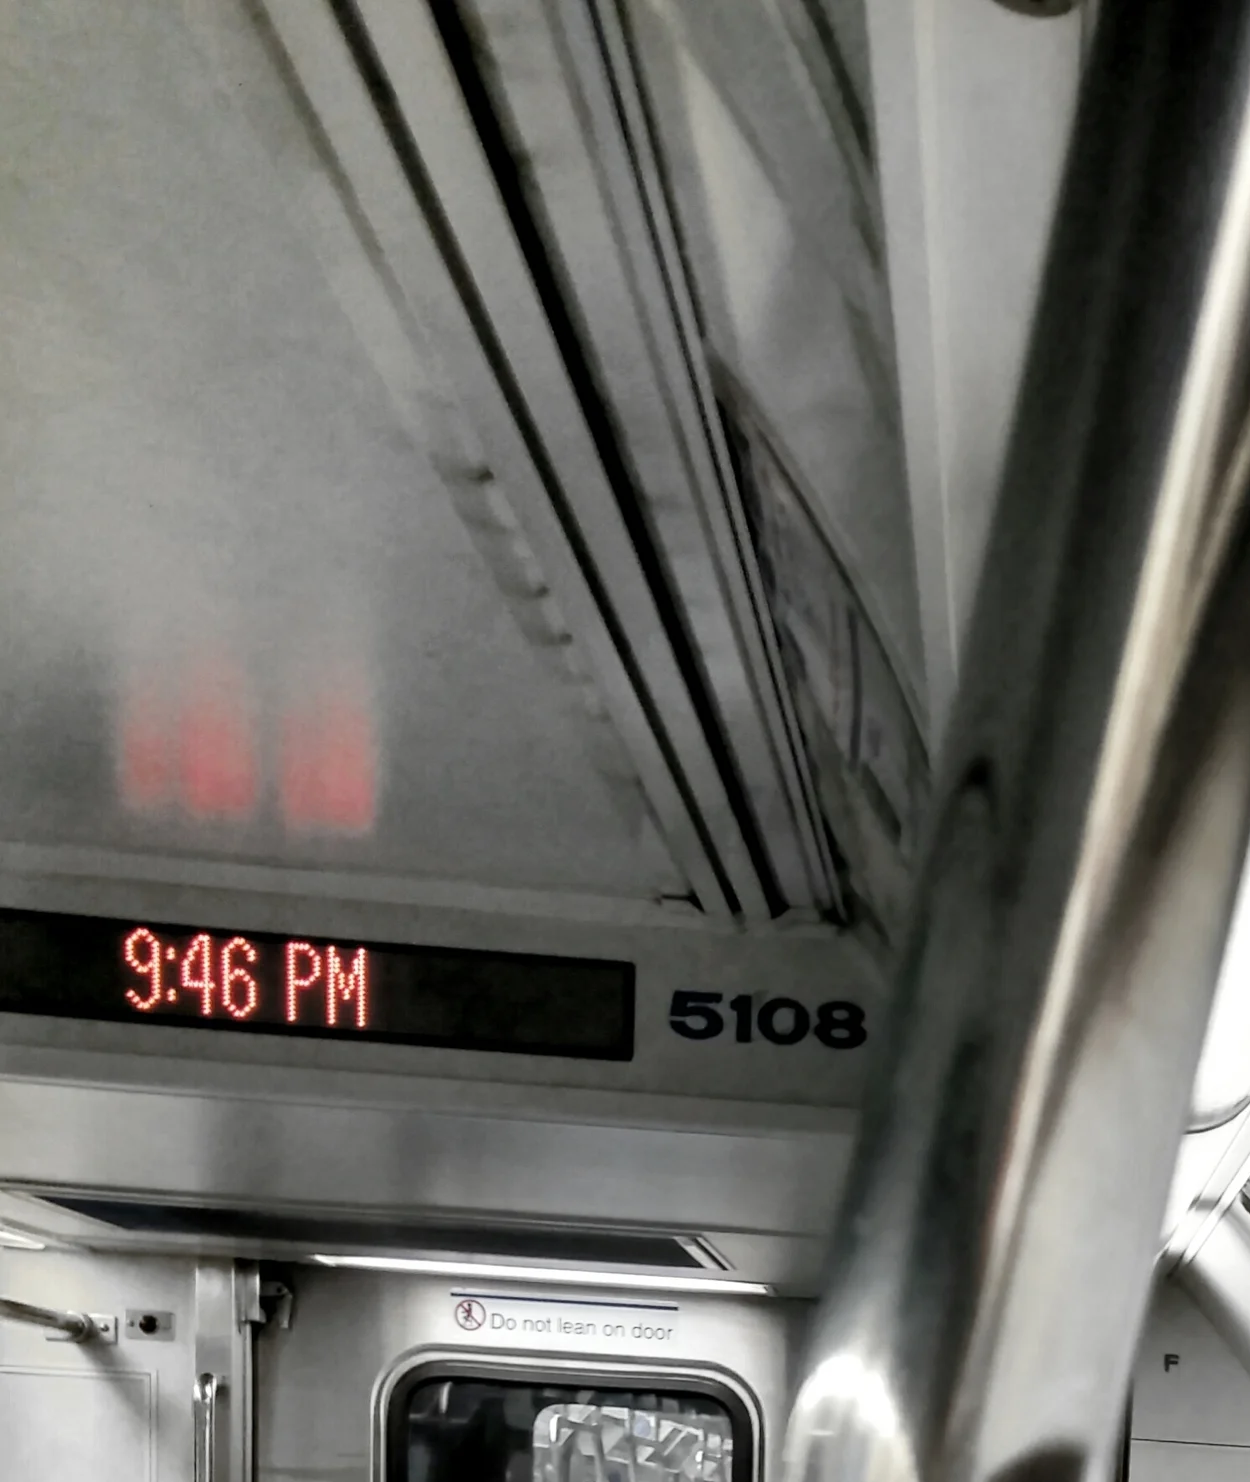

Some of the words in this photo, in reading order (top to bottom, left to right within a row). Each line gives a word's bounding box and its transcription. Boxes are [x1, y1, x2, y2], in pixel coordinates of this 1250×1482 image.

[125, 928, 256, 1017] 9:46
[285, 942, 367, 1028] PM
[669, 990, 868, 1050] 5108
[490, 1313, 518, 1331] Do
[523, 1318, 553, 1334] not
[557, 1318, 597, 1336] lean
[602, 1324, 626, 1338] on
[631, 1323, 674, 1340] door
[1164, 1353, 1180, 1373] F
